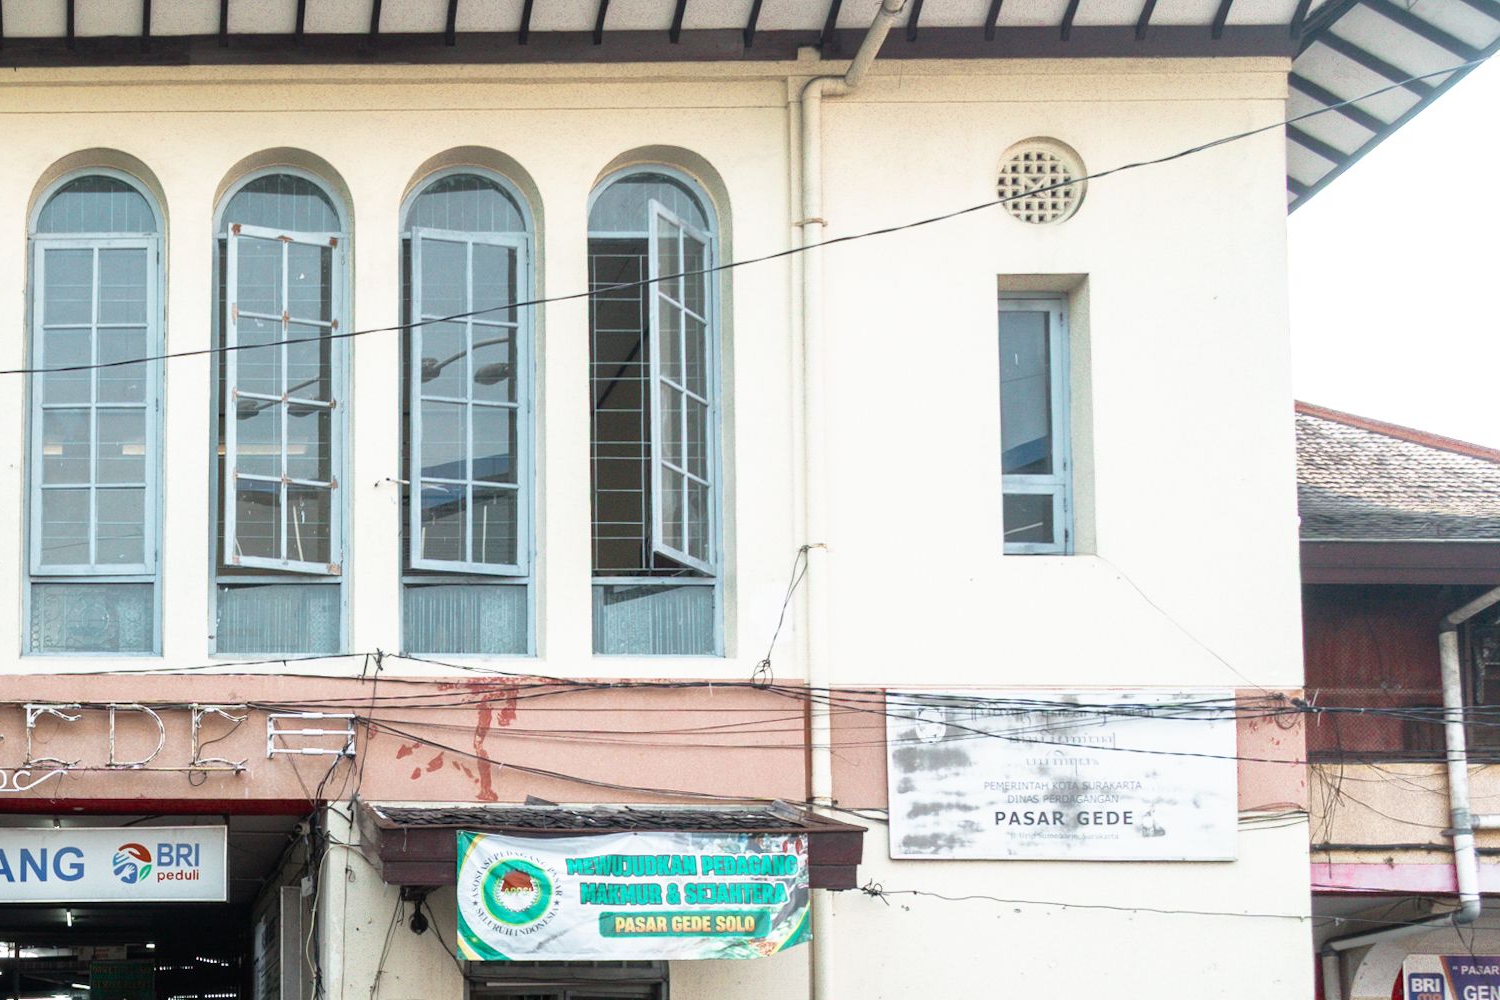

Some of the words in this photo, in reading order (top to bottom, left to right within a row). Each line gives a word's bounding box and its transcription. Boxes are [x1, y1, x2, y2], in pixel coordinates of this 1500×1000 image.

[983, 780, 1049, 791] PEMERINTAH
[1051, 780, 1079, 791] KOTA
[1082, 780, 1143, 791] SURAKARTA
[1007, 794, 1040, 804] DINAS
[1042, 794, 1120, 804] PERDAGANGAN
[994, 811, 1066, 826] PASAR
[1076, 811, 1134, 826] GEDE
[156, 842, 201, 867] BRI
[565, 854, 698, 877] MEWUJUDKAN
[700, 855, 799, 876] PEDAGANG
[156, 869, 201, 883] peduli
[579, 882, 663, 905] MAKMUR
[665, 883, 682, 905] &
[683, 882, 789, 905] SEJAHTERA
[614, 916, 668, 933] PASAR
[671, 915, 712, 932] GEDE
[715, 915, 756, 932] SOLO
[1411, 977, 1441, 993] BRI
